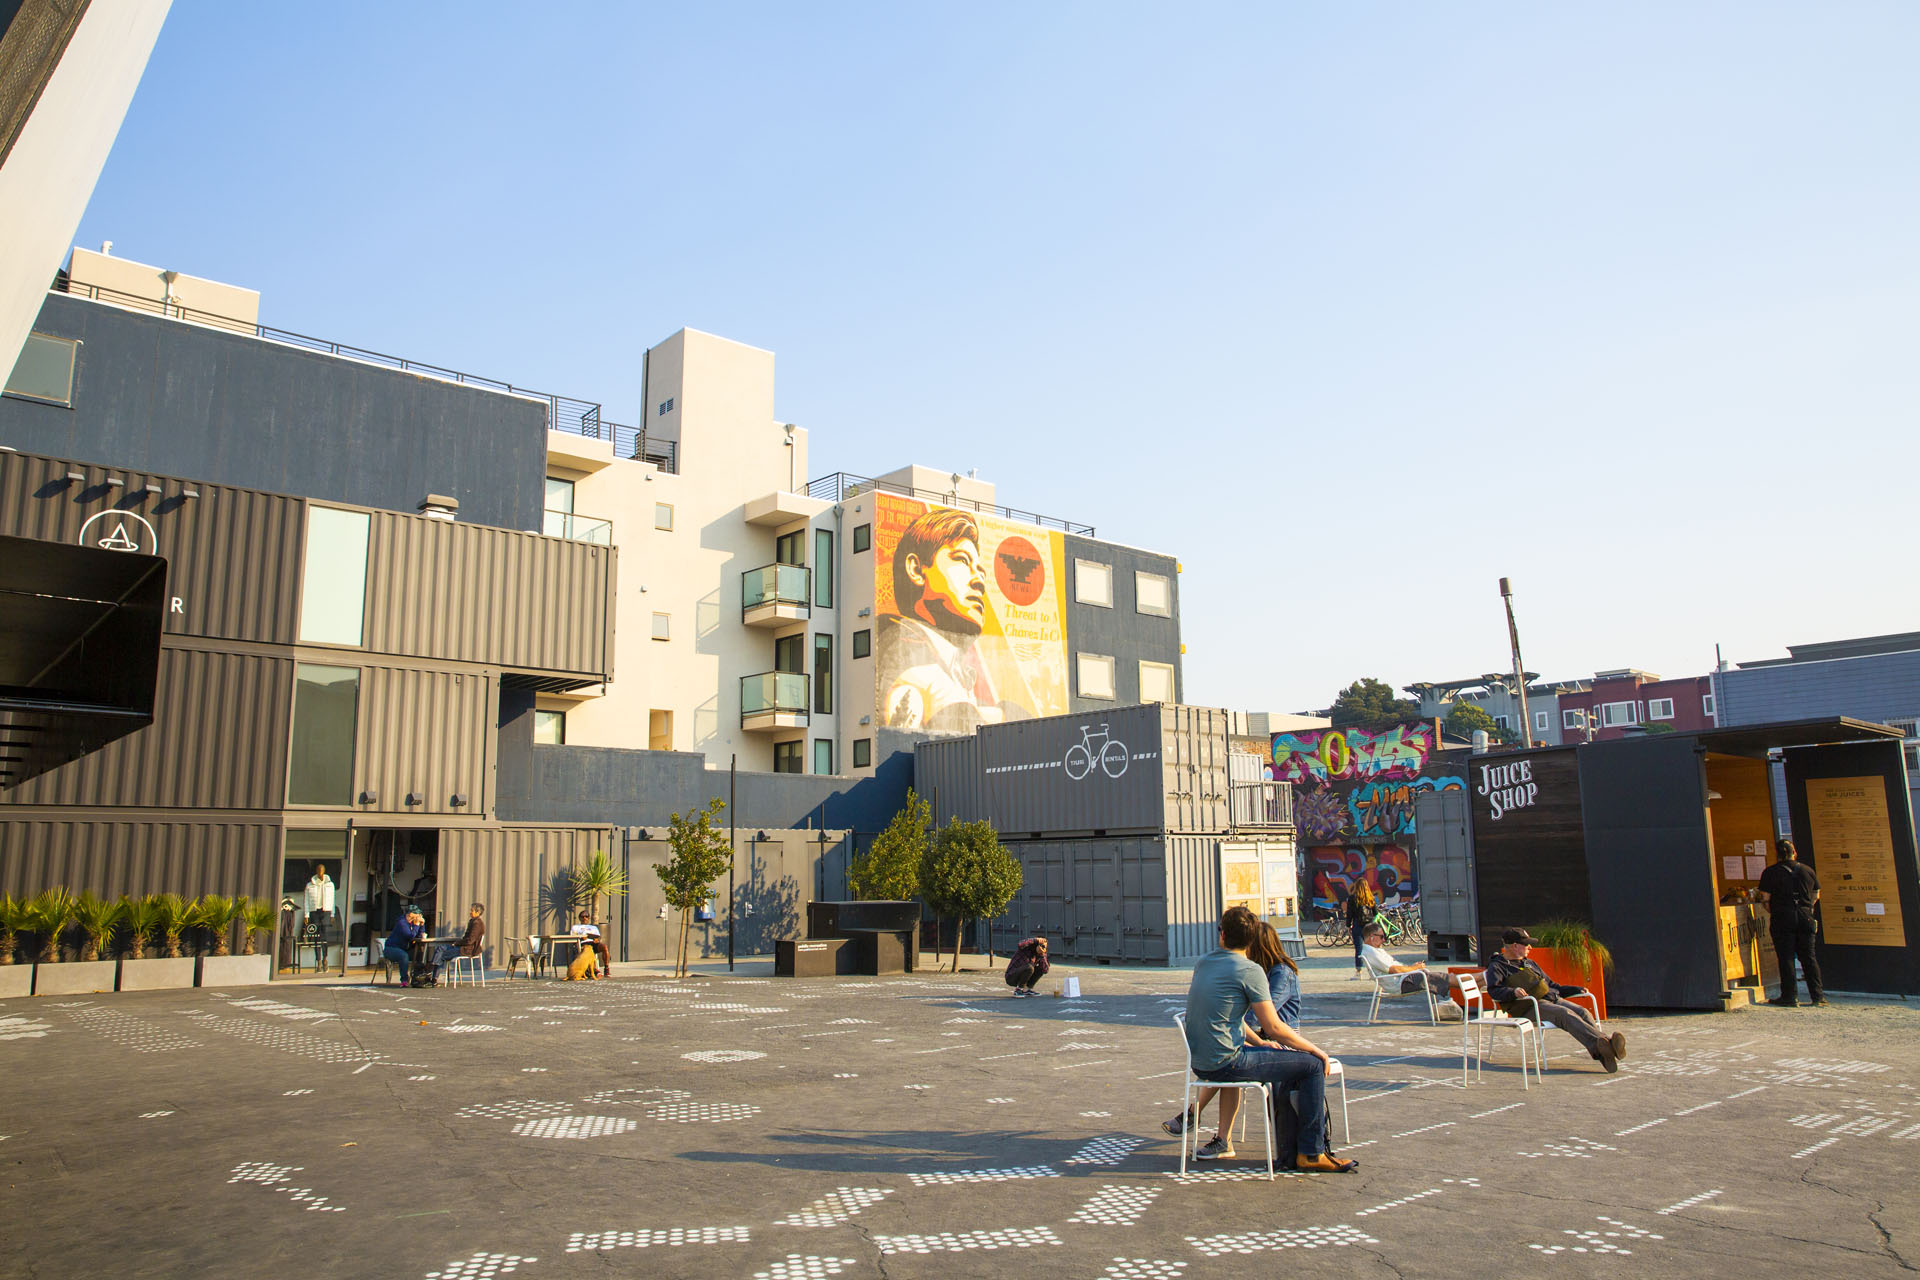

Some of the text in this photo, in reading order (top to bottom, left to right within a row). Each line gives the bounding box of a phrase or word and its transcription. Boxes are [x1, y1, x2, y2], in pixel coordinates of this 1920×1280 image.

[1005, 604, 1037, 621] Threat
[1040, 611, 1050, 624] to
[1478, 760, 1533, 796] JUICE
[1490, 783, 1538, 820] SHOP
[1840, 791, 1865, 799] JUICES
